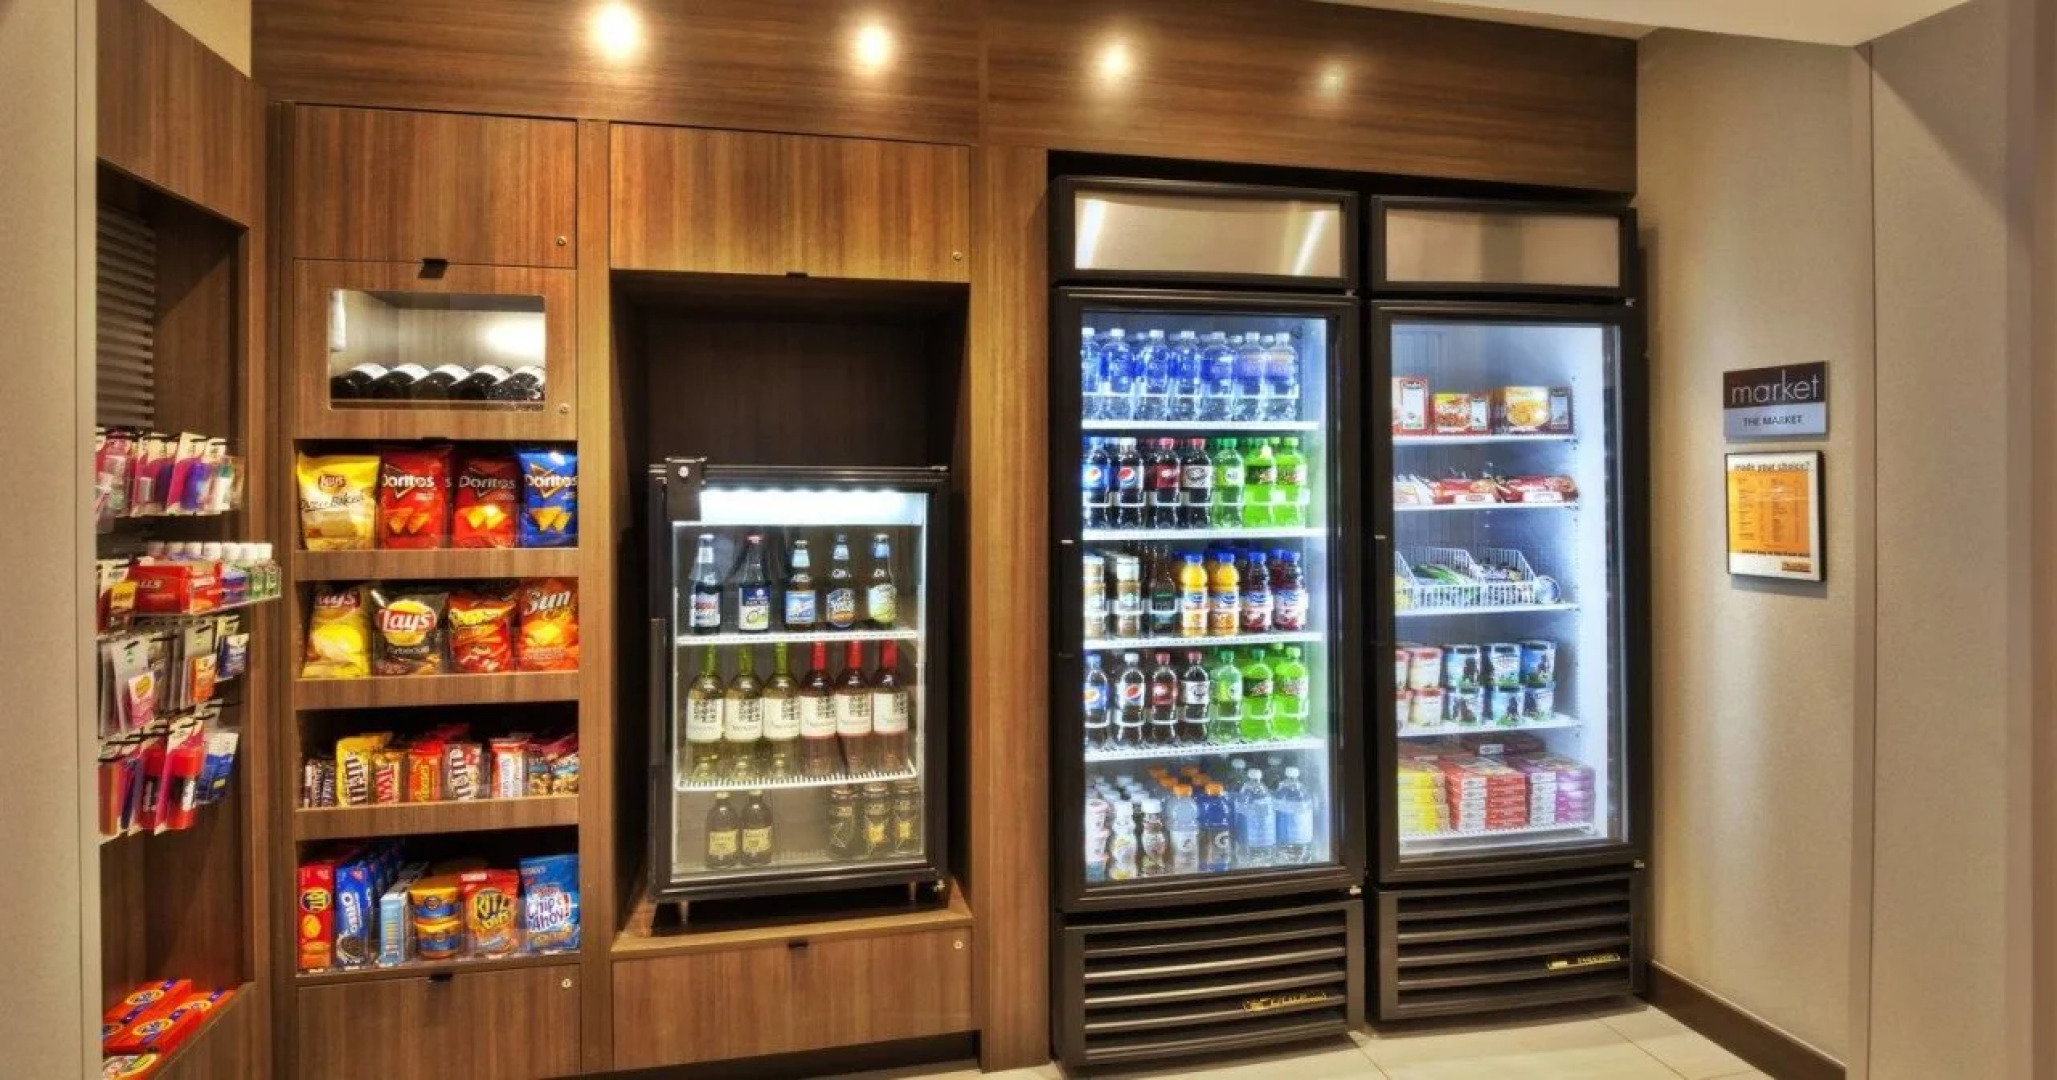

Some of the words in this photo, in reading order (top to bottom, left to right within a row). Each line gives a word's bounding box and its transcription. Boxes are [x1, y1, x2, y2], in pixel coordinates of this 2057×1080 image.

[1731, 367, 1819, 405] market
[1743, 417, 1760, 427] THE
[1762, 414, 1803, 426] MARKET
[459, 474, 517, 489] Doritos
